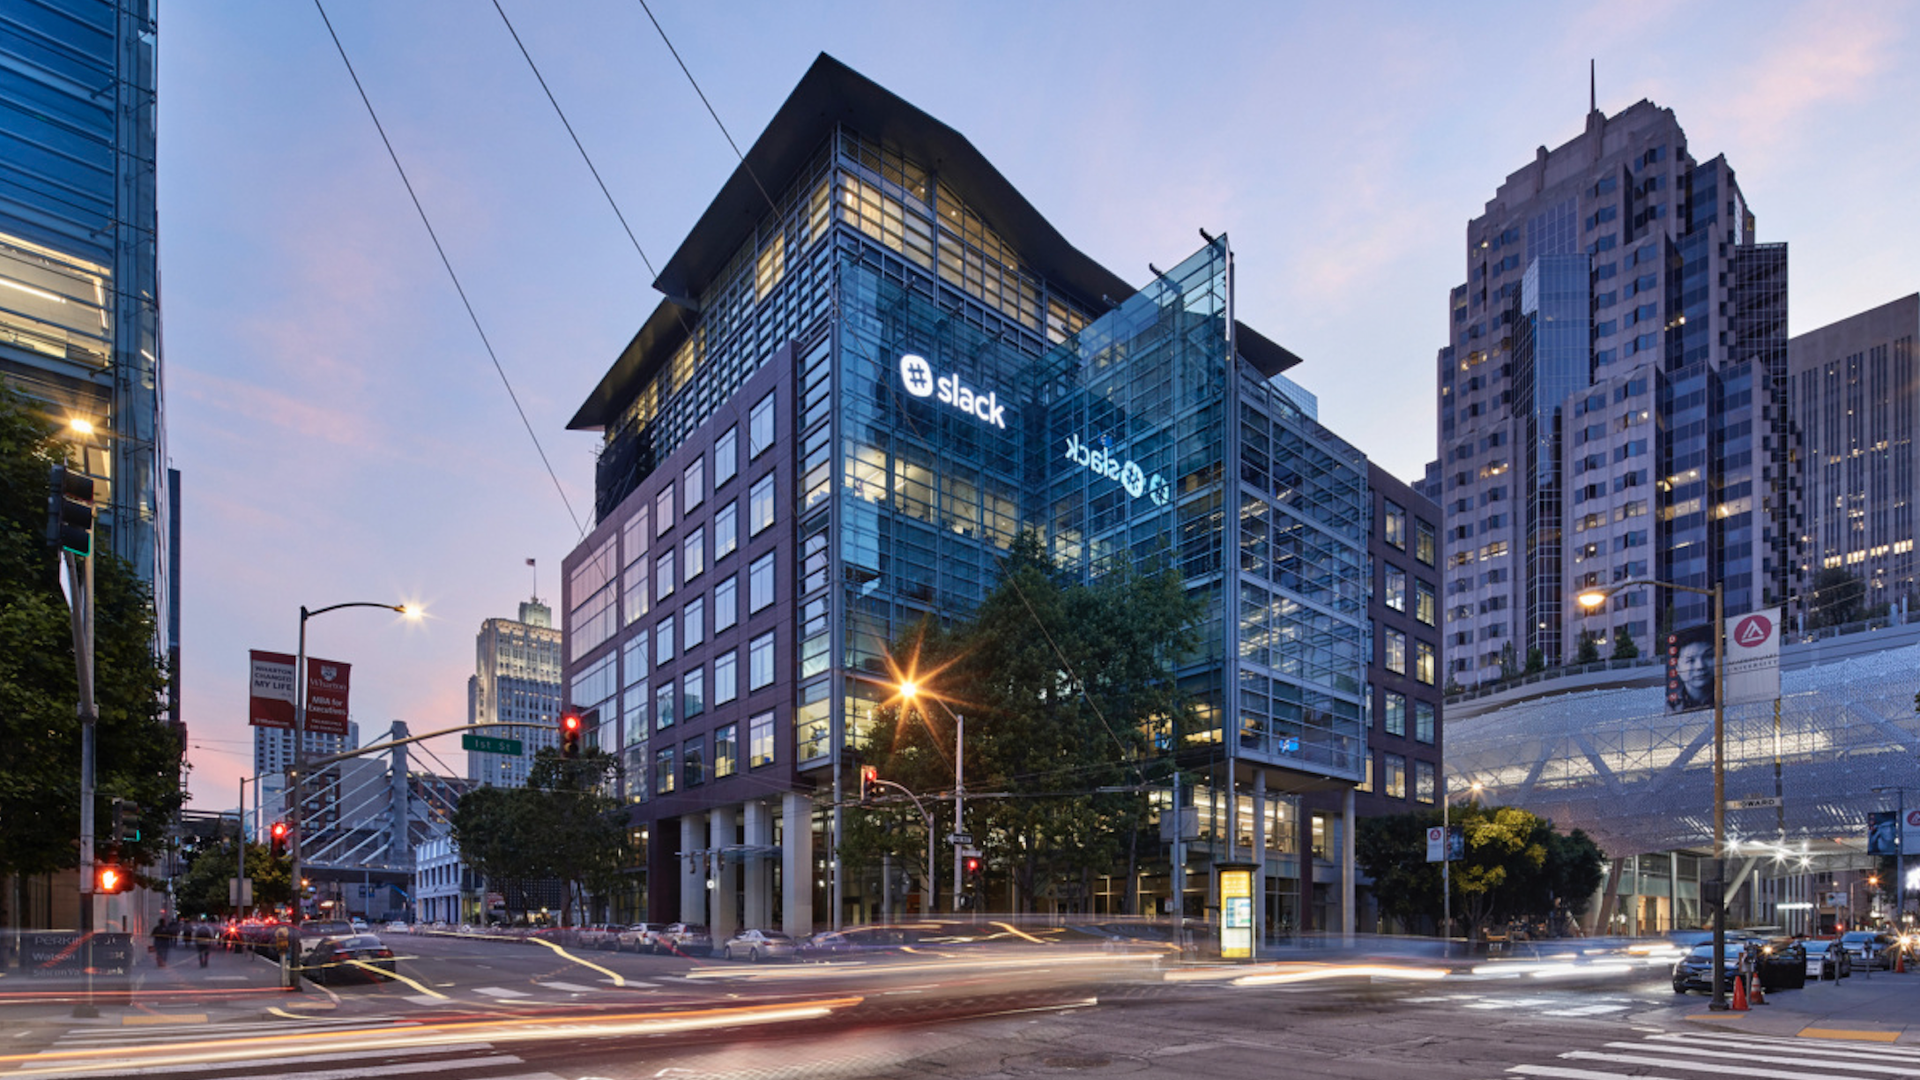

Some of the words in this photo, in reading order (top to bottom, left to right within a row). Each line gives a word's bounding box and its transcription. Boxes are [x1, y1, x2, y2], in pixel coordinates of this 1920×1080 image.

[937, 373, 1006, 429] slack
[255, 667, 292, 675] WHARTON
[254, 673, 292, 682] CHANGED
[475, 740, 491, 750] 1st
[499, 741, 511, 752] St
